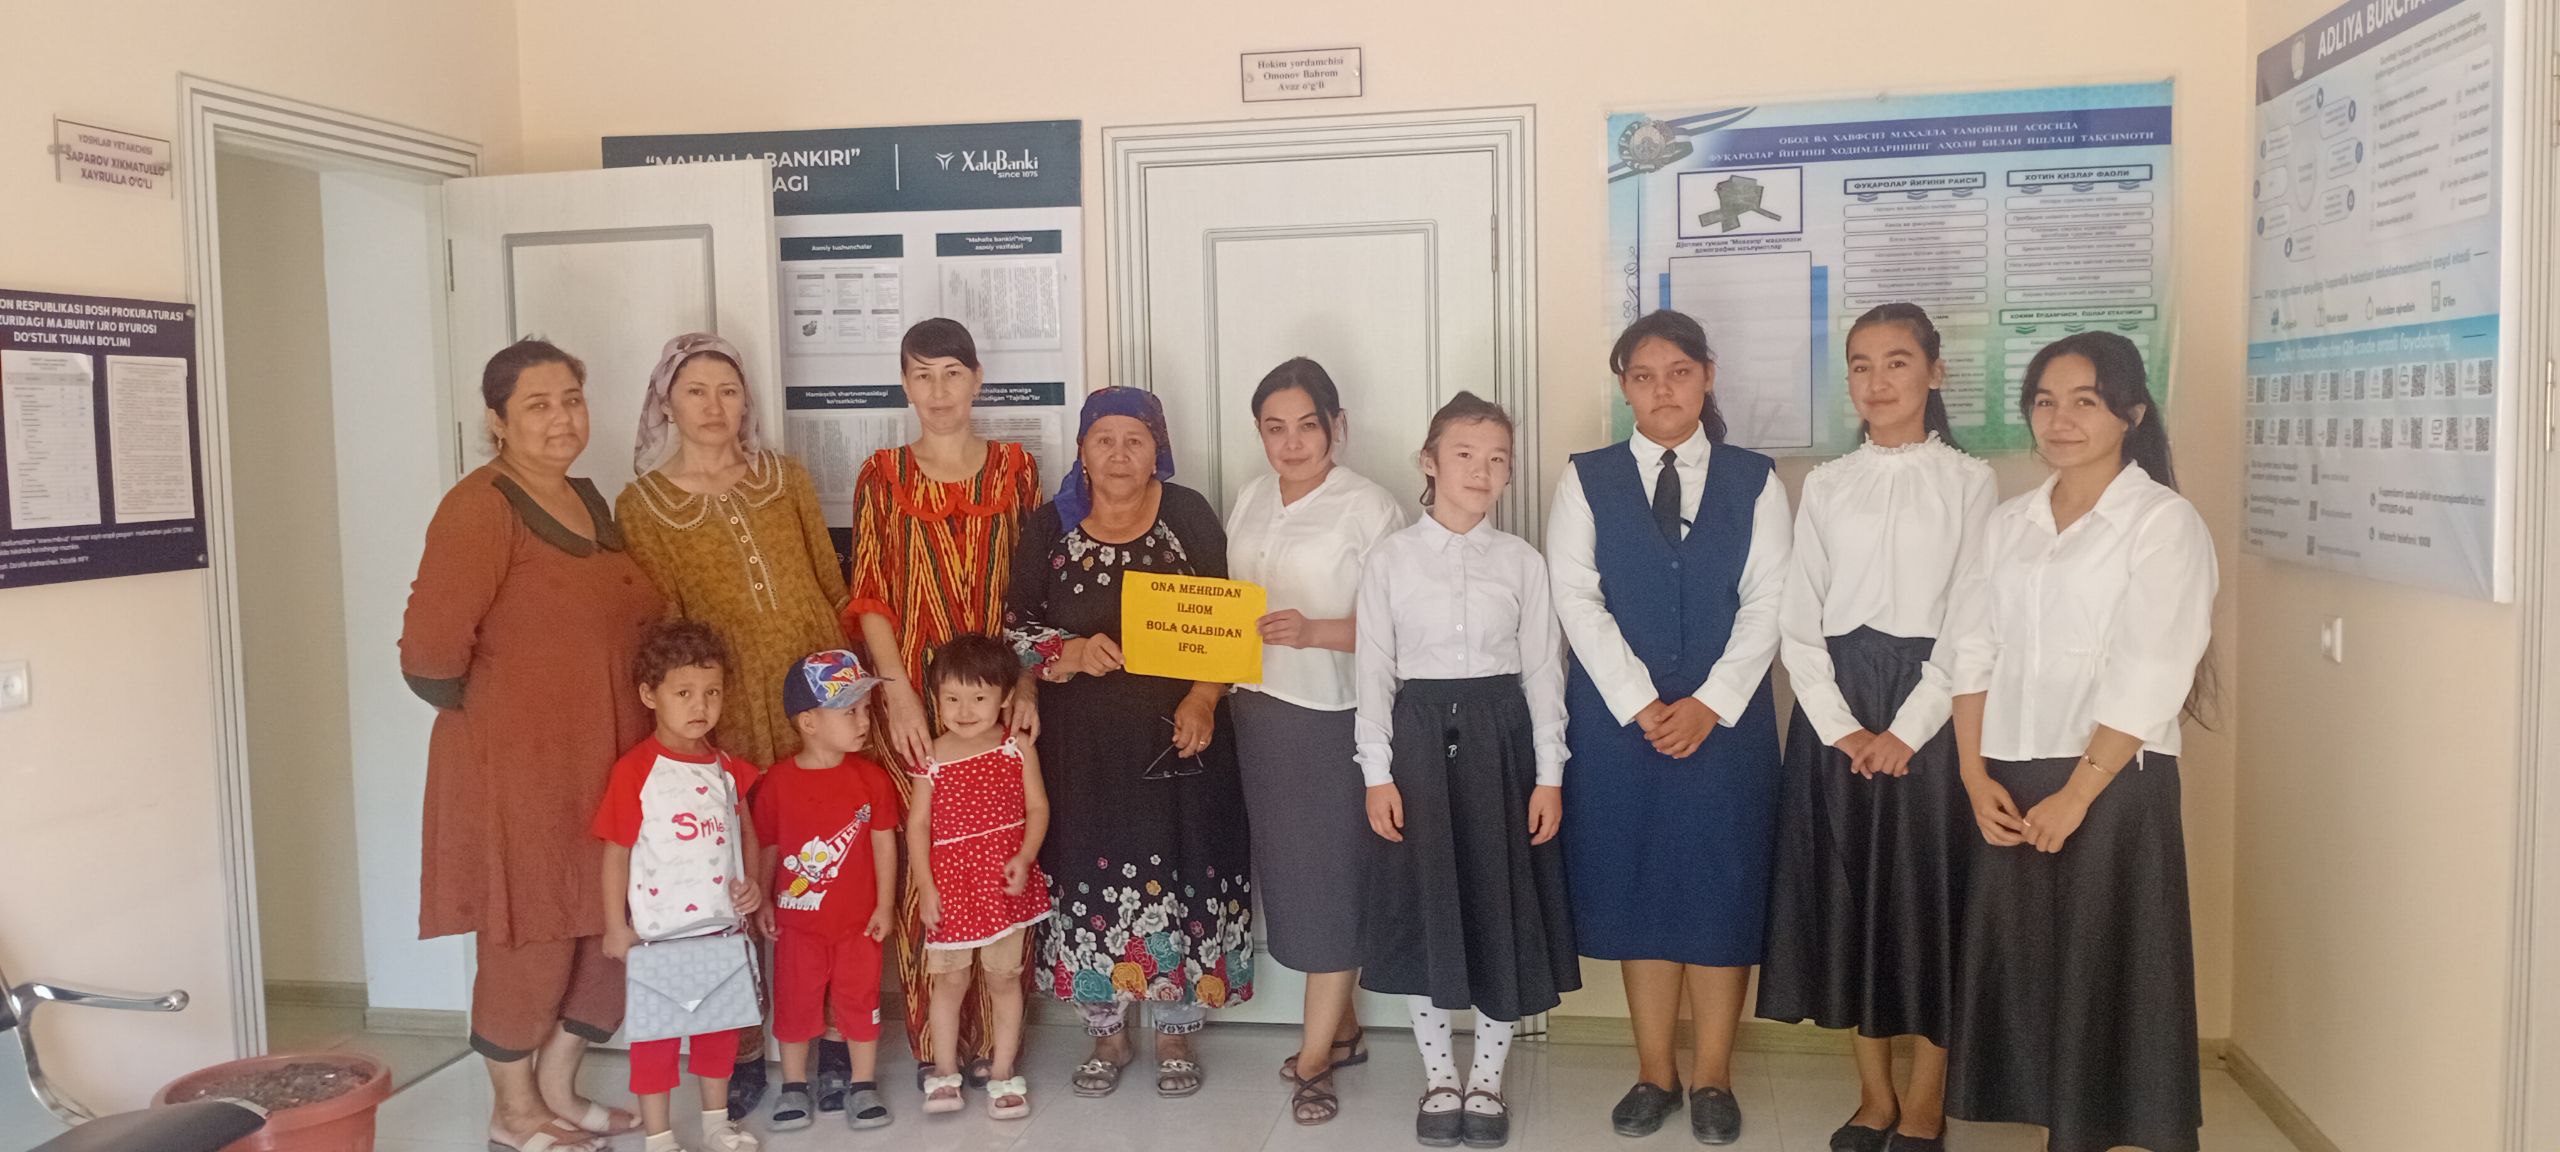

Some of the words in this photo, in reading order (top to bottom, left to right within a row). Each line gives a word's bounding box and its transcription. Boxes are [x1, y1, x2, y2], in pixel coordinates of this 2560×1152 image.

[2318, 10, 2363, 60] ADLIYA
[1258, 60, 1287, 70] Hokim
[1290, 57, 1344, 68] yordamchisi
[1263, 72, 1299, 80] Omonov
[1303, 69, 1338, 78] Bahrom
[1779, 136, 1809, 145] ОБОД
[1814, 135, 1828, 144] ВА
[2024, 121, 2078, 132] АСОСИДА
[78, 134, 112, 148] YOSHLAR
[114, 140, 153, 156] YETAKCHISI
[66, 151, 109, 168] SAPAROV
[81, 168, 127, 185] XAYRULLA
[773, 176, 809, 192] AGI
[16, 300, 83, 315] RESPUBLIKASI
[85, 305, 110, 316] BOSH
[112, 307, 184, 322] PROKURATURASI
[46, 318, 94, 330] MAJBURIY
[97, 320, 117, 332] IJRO
[118, 323, 157, 334] BYUROSI
[60, 334, 96, 346] TUMAN
[1151, 581, 1176, 592] ONA
[1179, 584, 1242, 598] MEHRIDAN
[1177, 602, 1213, 616] ILHOM
[1146, 620, 1178, 632] BOLA
[1181, 623, 1242, 638] QALBIDAN
[1178, 642, 1208, 655] IFOR.
